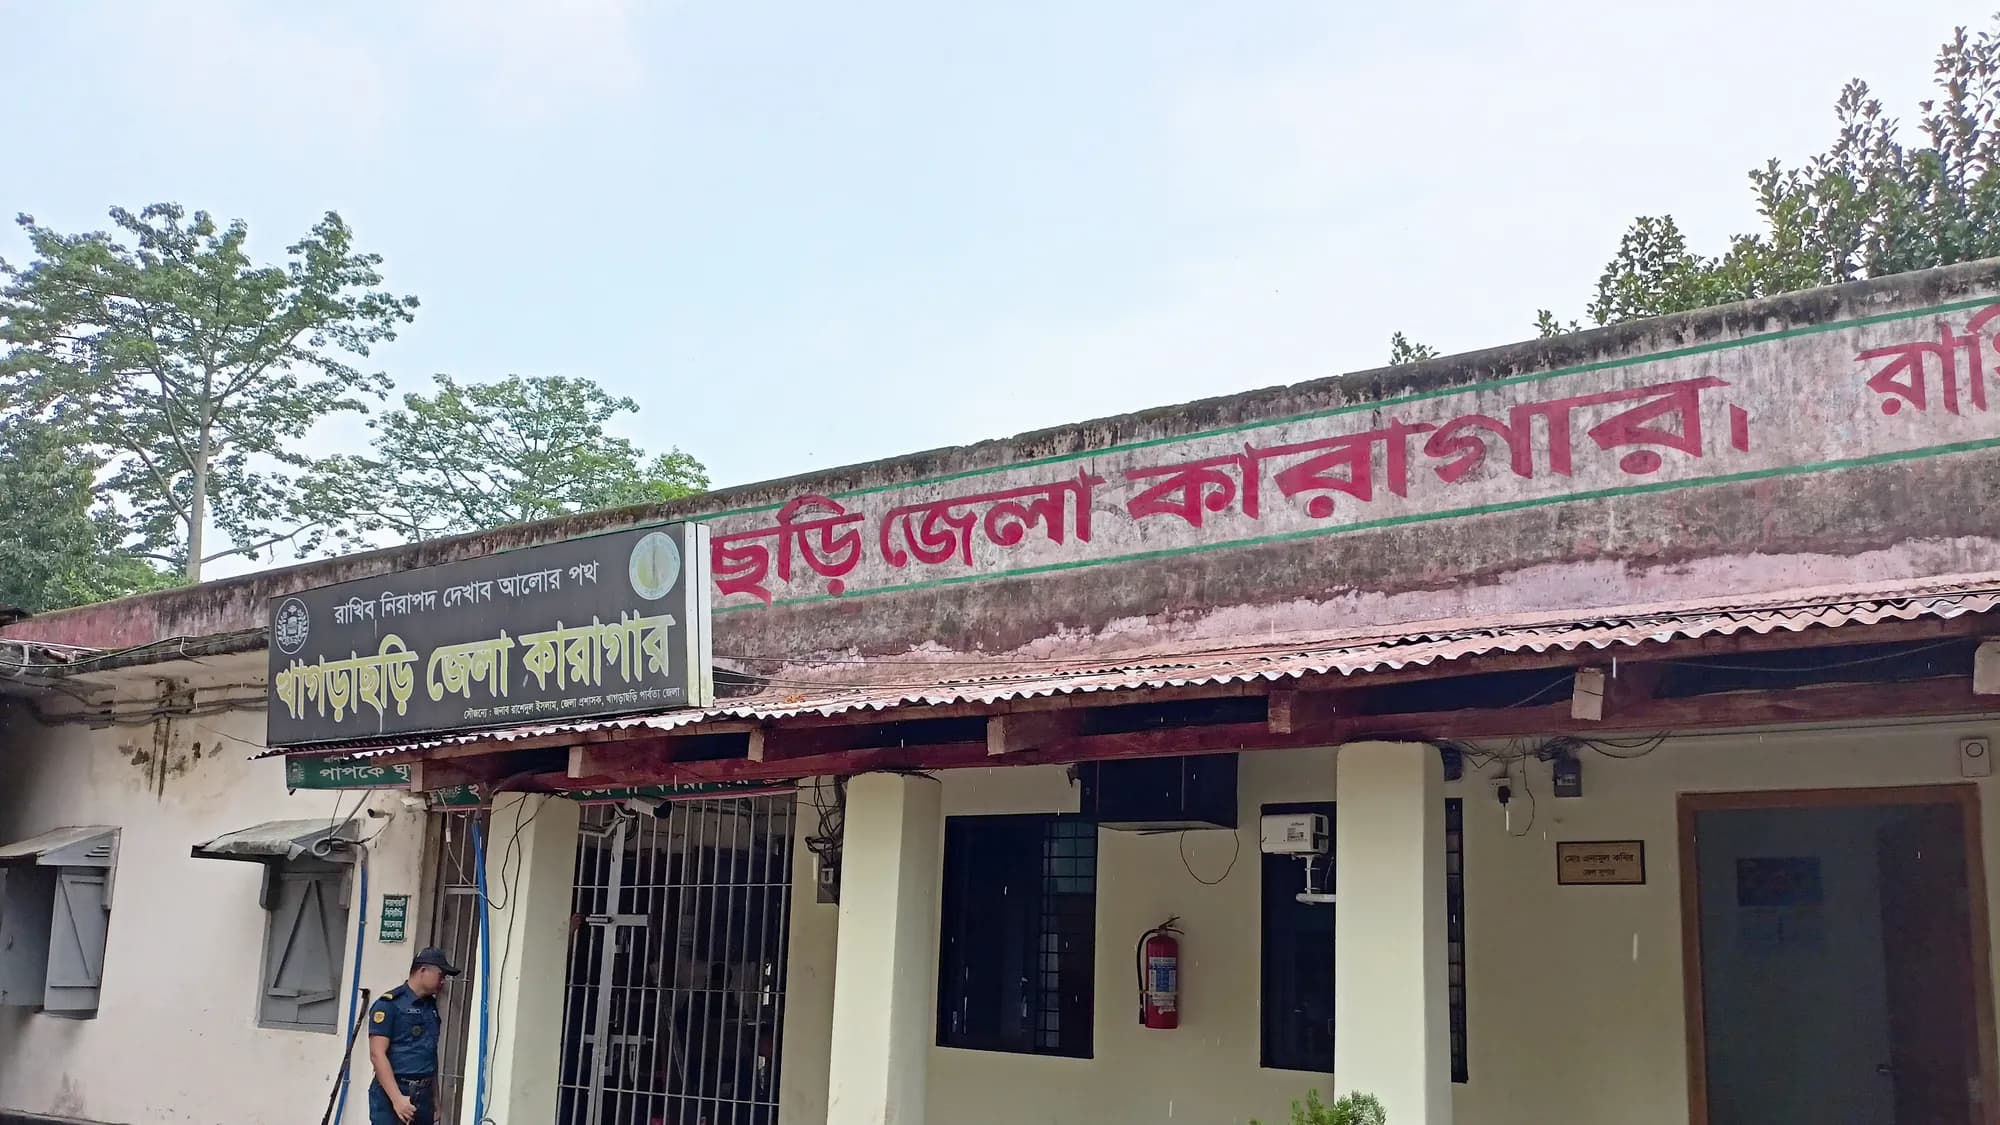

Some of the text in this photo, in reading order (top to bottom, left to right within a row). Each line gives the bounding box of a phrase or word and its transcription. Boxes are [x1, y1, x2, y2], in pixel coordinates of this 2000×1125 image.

[880, 464, 1107, 568] জেলা
[333, 596, 376, 624] রাখিব
[379, 591, 438, 618] নিরাপদ
[443, 580, 493, 608] দেখাব
[497, 568, 562, 597] আলোর
[568, 559, 600, 586] পথ
[275, 609, 676, 723] খাগড়াছড়ি জেলা কারাগার
[319, 765, 385, 781] পাপকে
